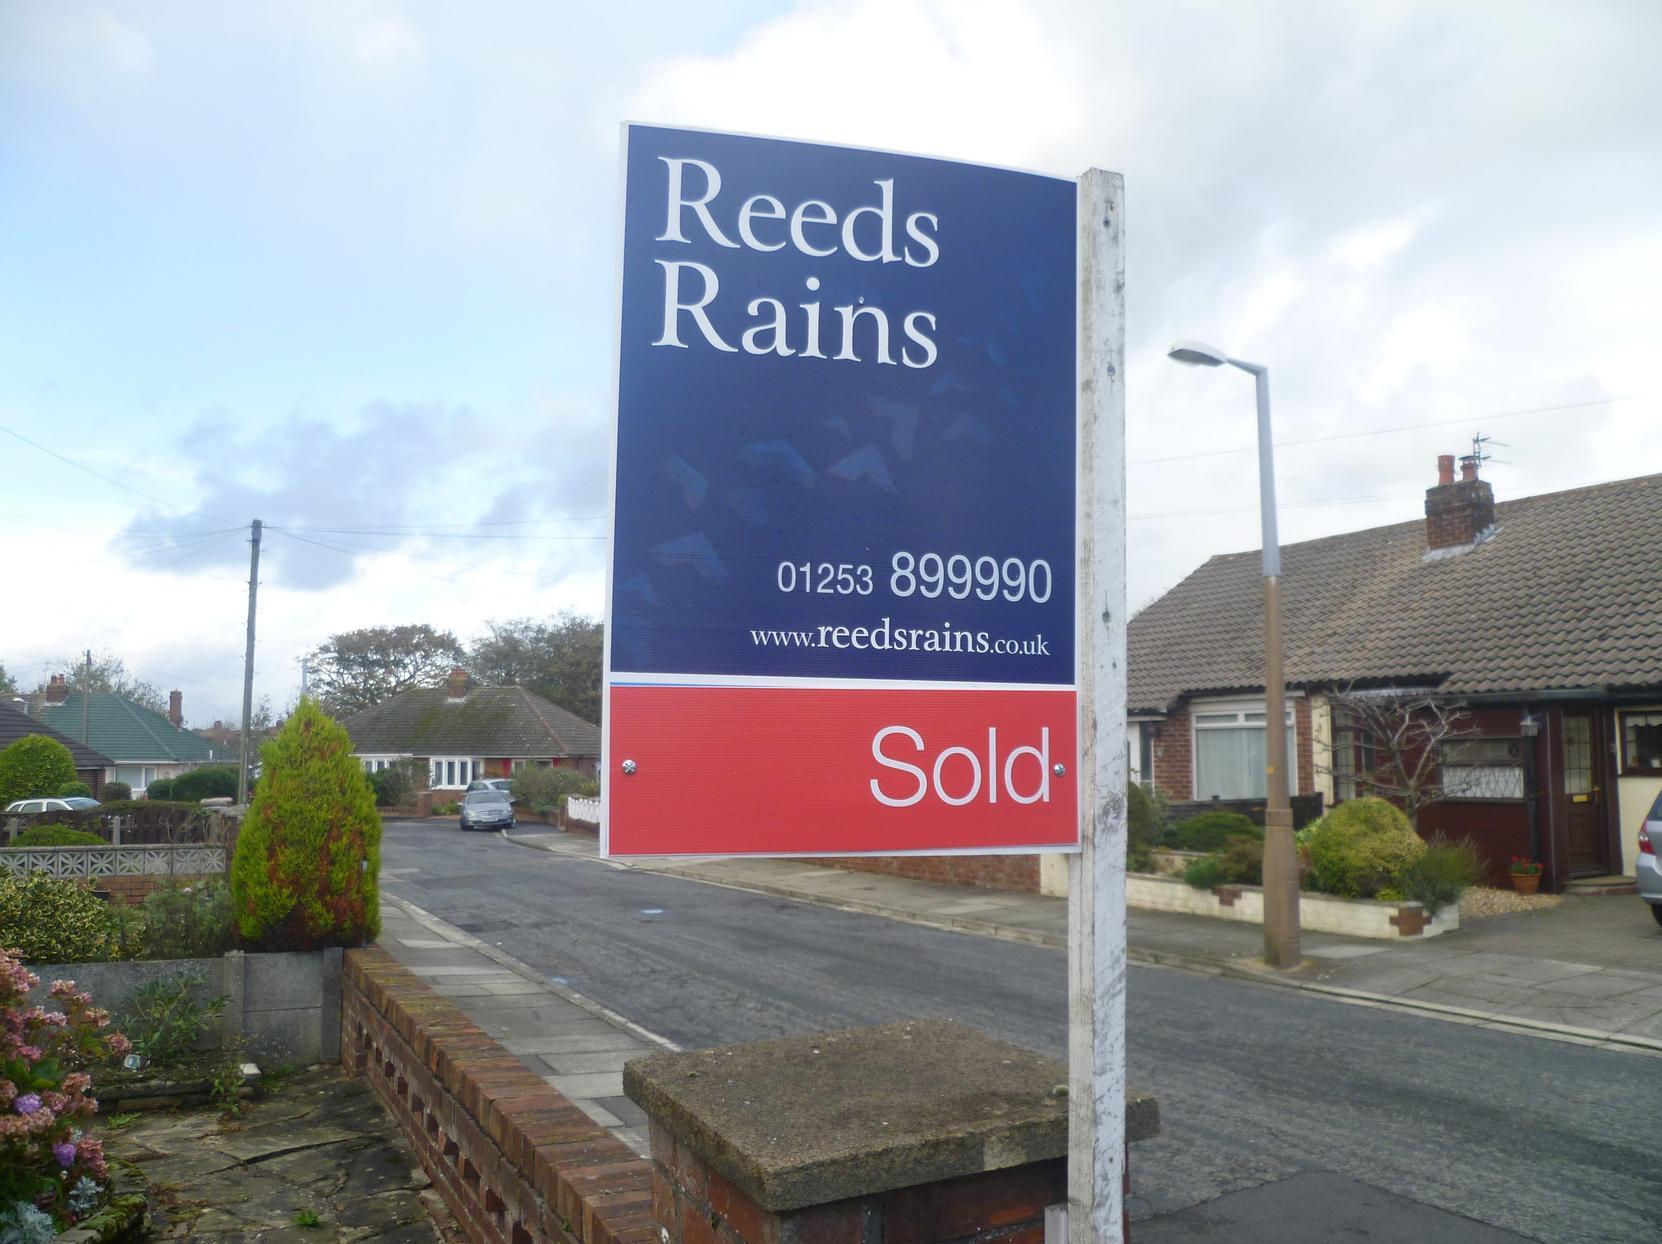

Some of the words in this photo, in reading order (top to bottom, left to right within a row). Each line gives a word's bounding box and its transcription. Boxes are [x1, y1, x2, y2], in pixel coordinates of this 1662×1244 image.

[655, 155, 940, 268] Reeds
[651, 258, 938, 369] Rains
[776, 561, 874, 596] 01253
[890, 551, 1052, 602] 899990
[750, 616, 1049, 657] www.reedsrains.co.uk
[869, 725, 1050, 808] Sold
